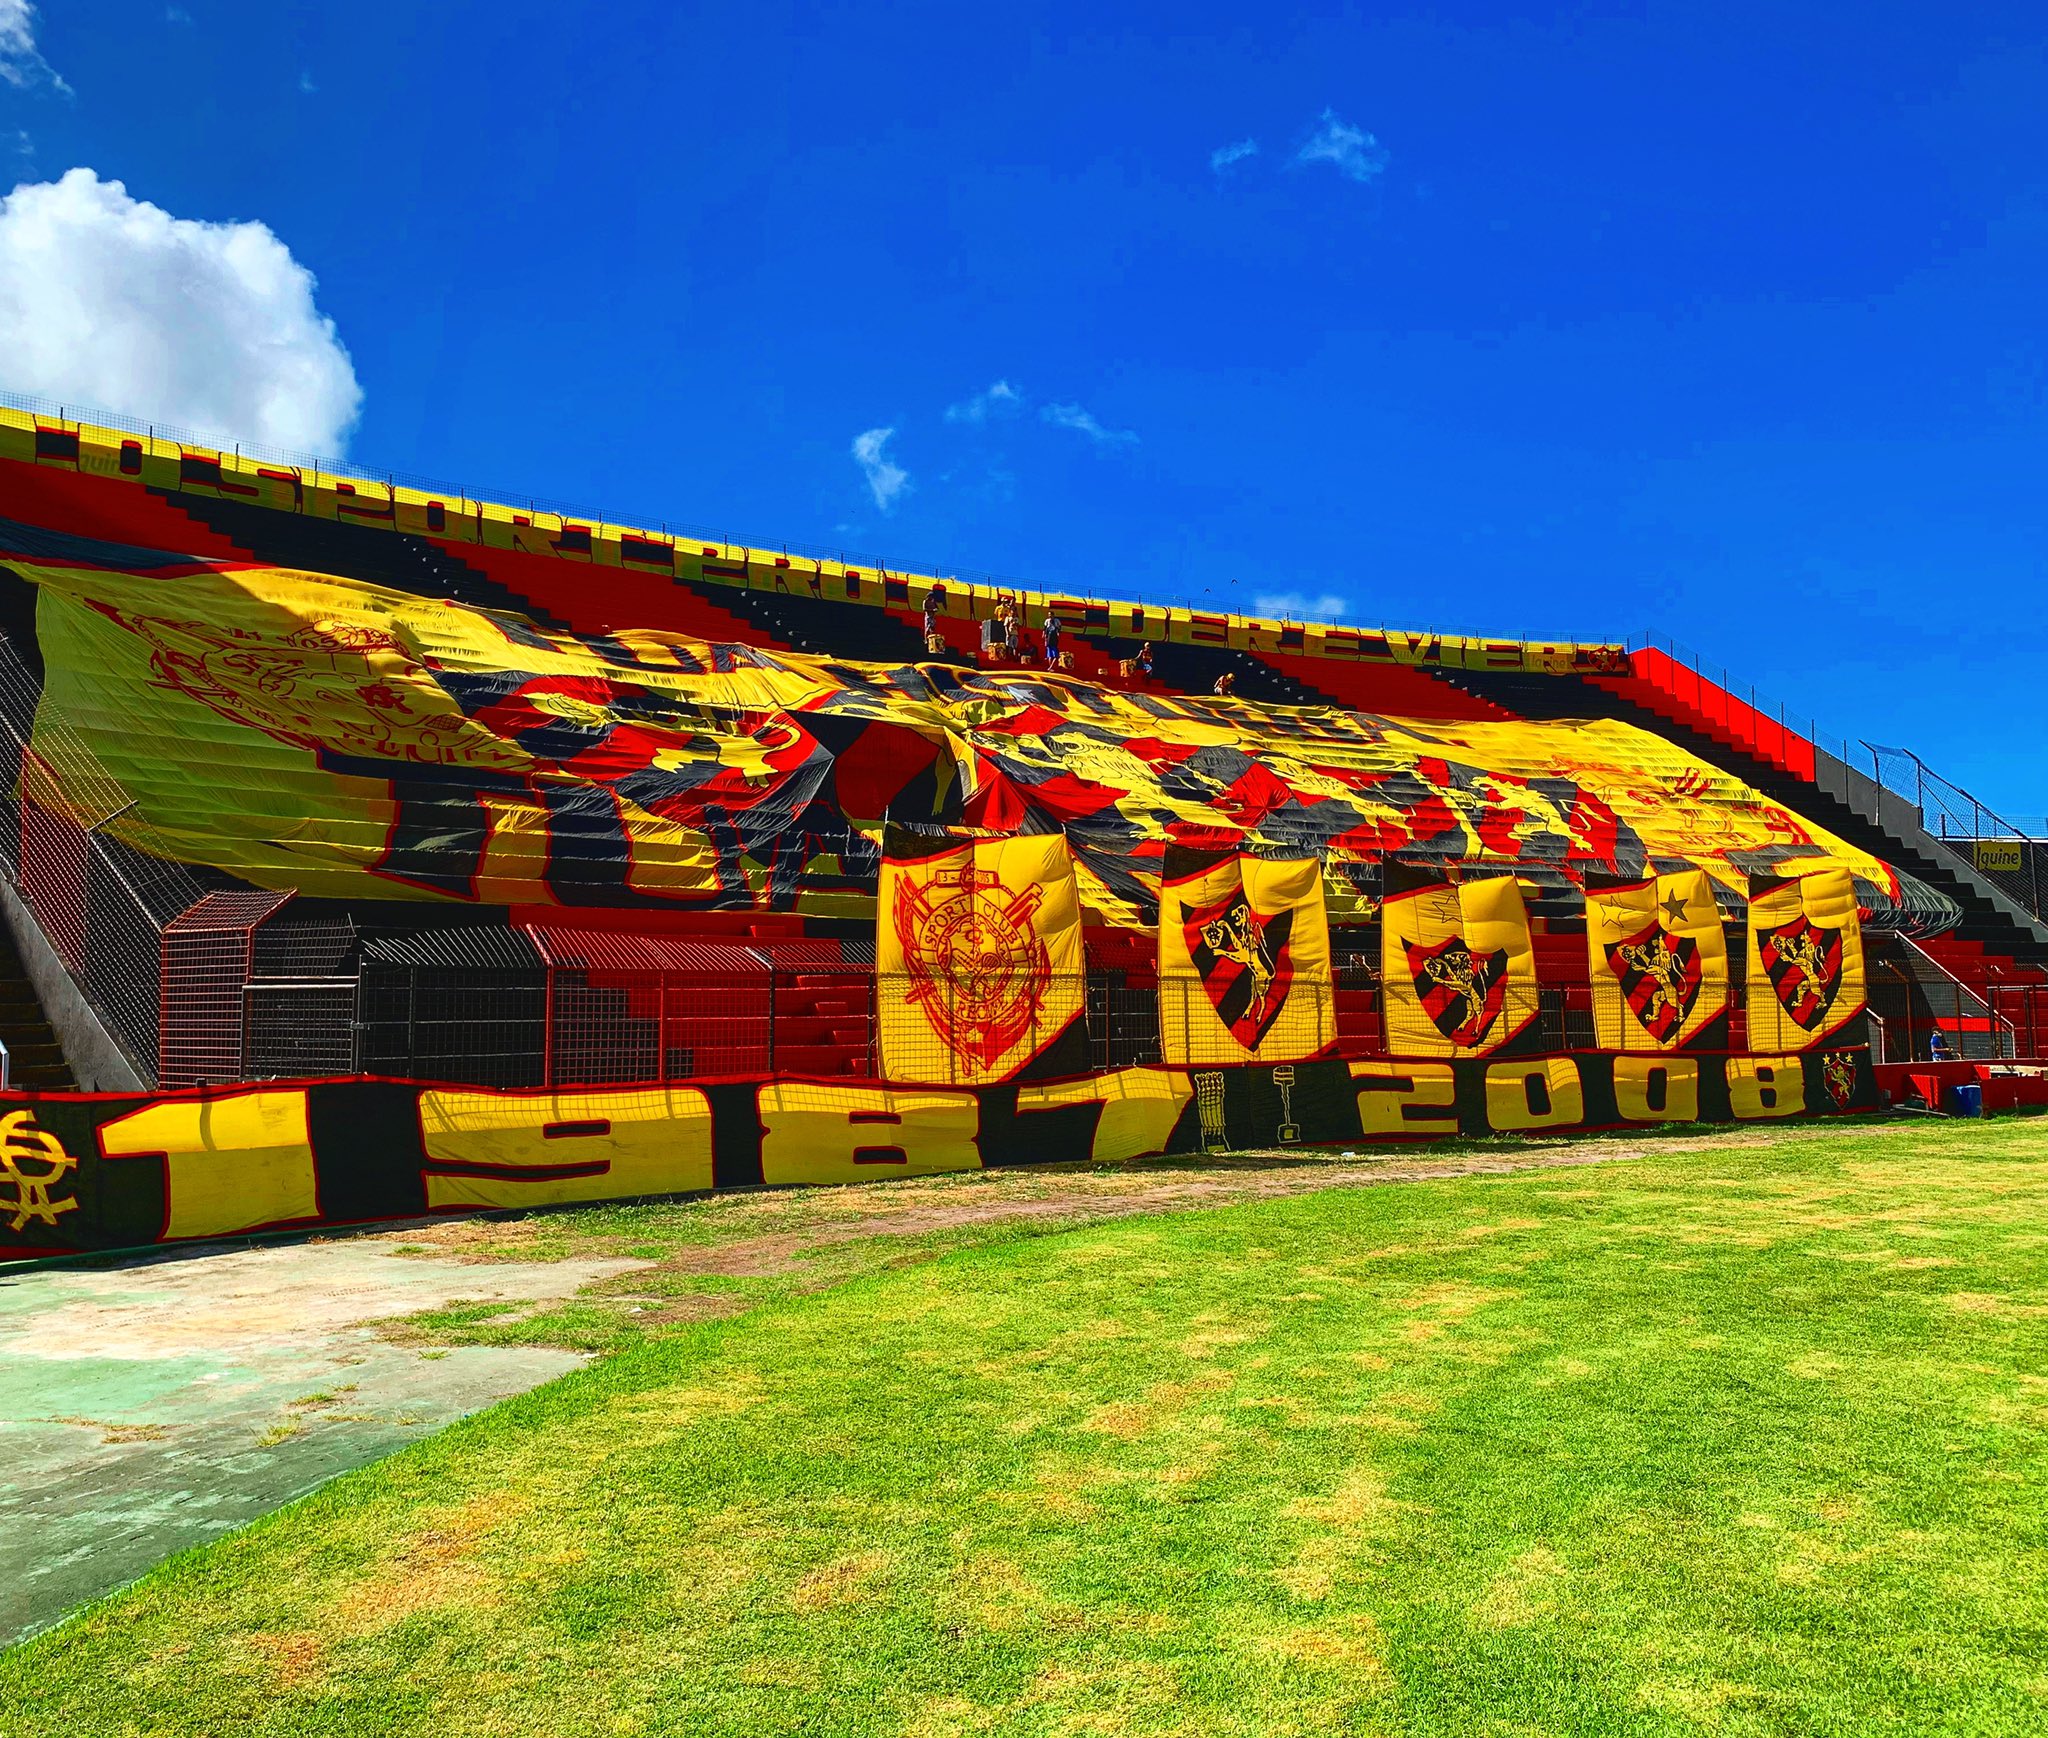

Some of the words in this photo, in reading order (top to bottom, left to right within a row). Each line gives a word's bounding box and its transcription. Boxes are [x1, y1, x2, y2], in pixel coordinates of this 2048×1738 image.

[218, 452, 646, 570] SPORT
[672, 536, 887, 608] PRO
[1107, 600, 1283, 656] DER
[1303, 622, 1360, 662] E
[1381, 629, 1580, 675] VIER
[925, 897, 967, 945] SPORT
[983, 903, 1022, 945] CLUB
[97, 1067, 1193, 1240] 1987
[1346, 1056, 1806, 1135] 2008
